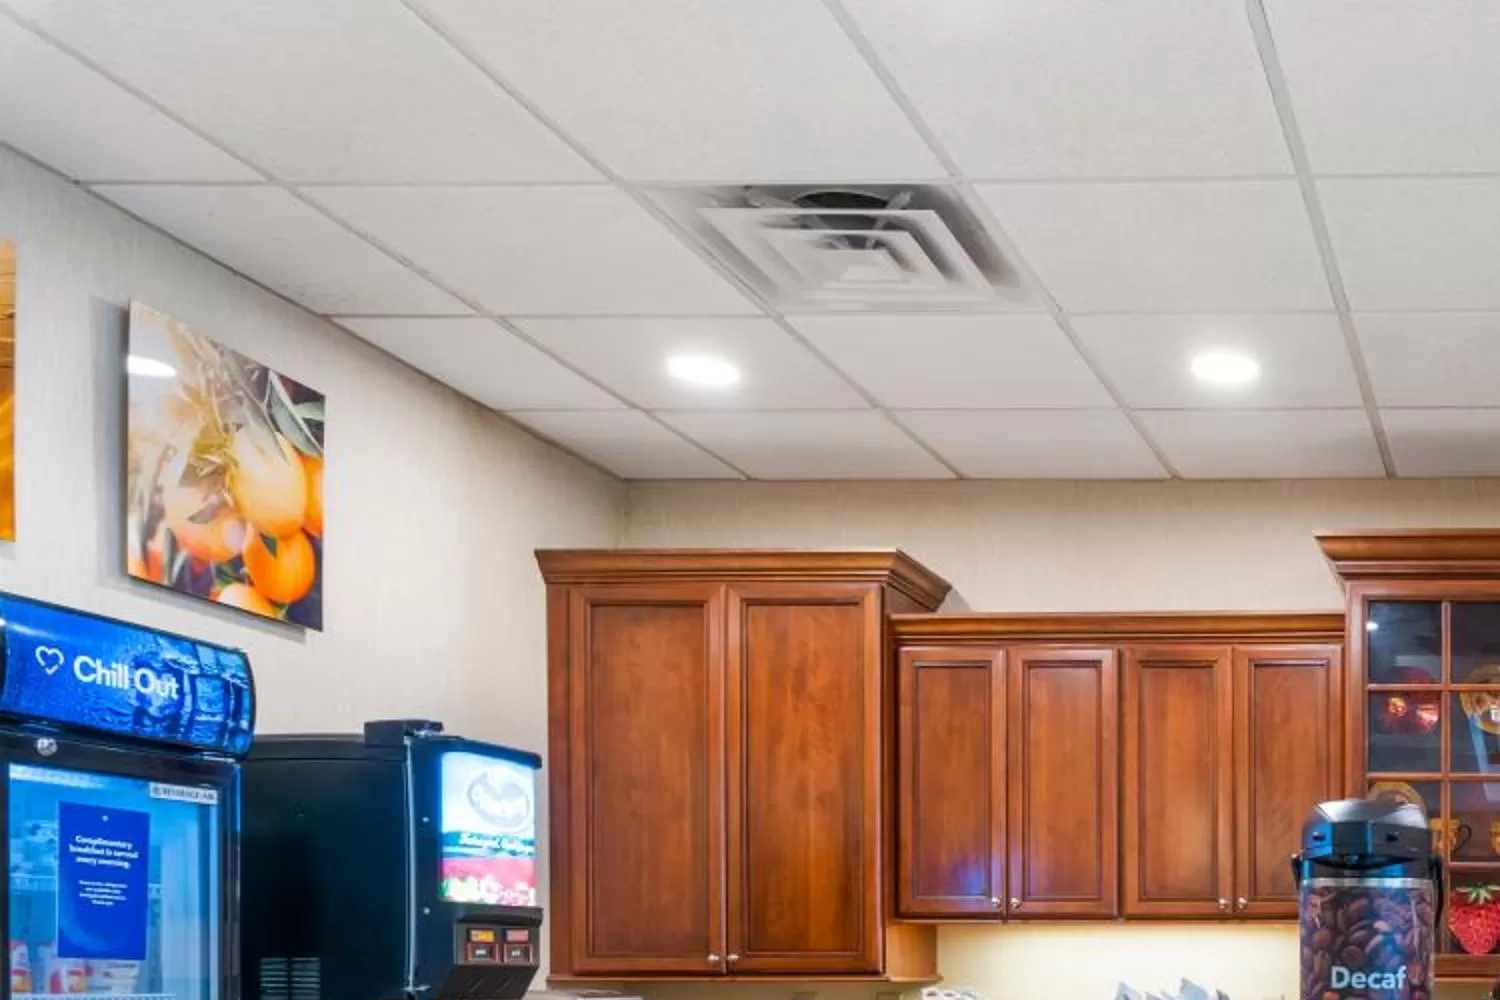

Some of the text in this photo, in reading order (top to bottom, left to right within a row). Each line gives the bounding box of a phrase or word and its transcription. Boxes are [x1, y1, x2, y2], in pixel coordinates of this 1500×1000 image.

[73, 655, 180, 700] Chill Out
[1331, 965, 1407, 989] Decaf
